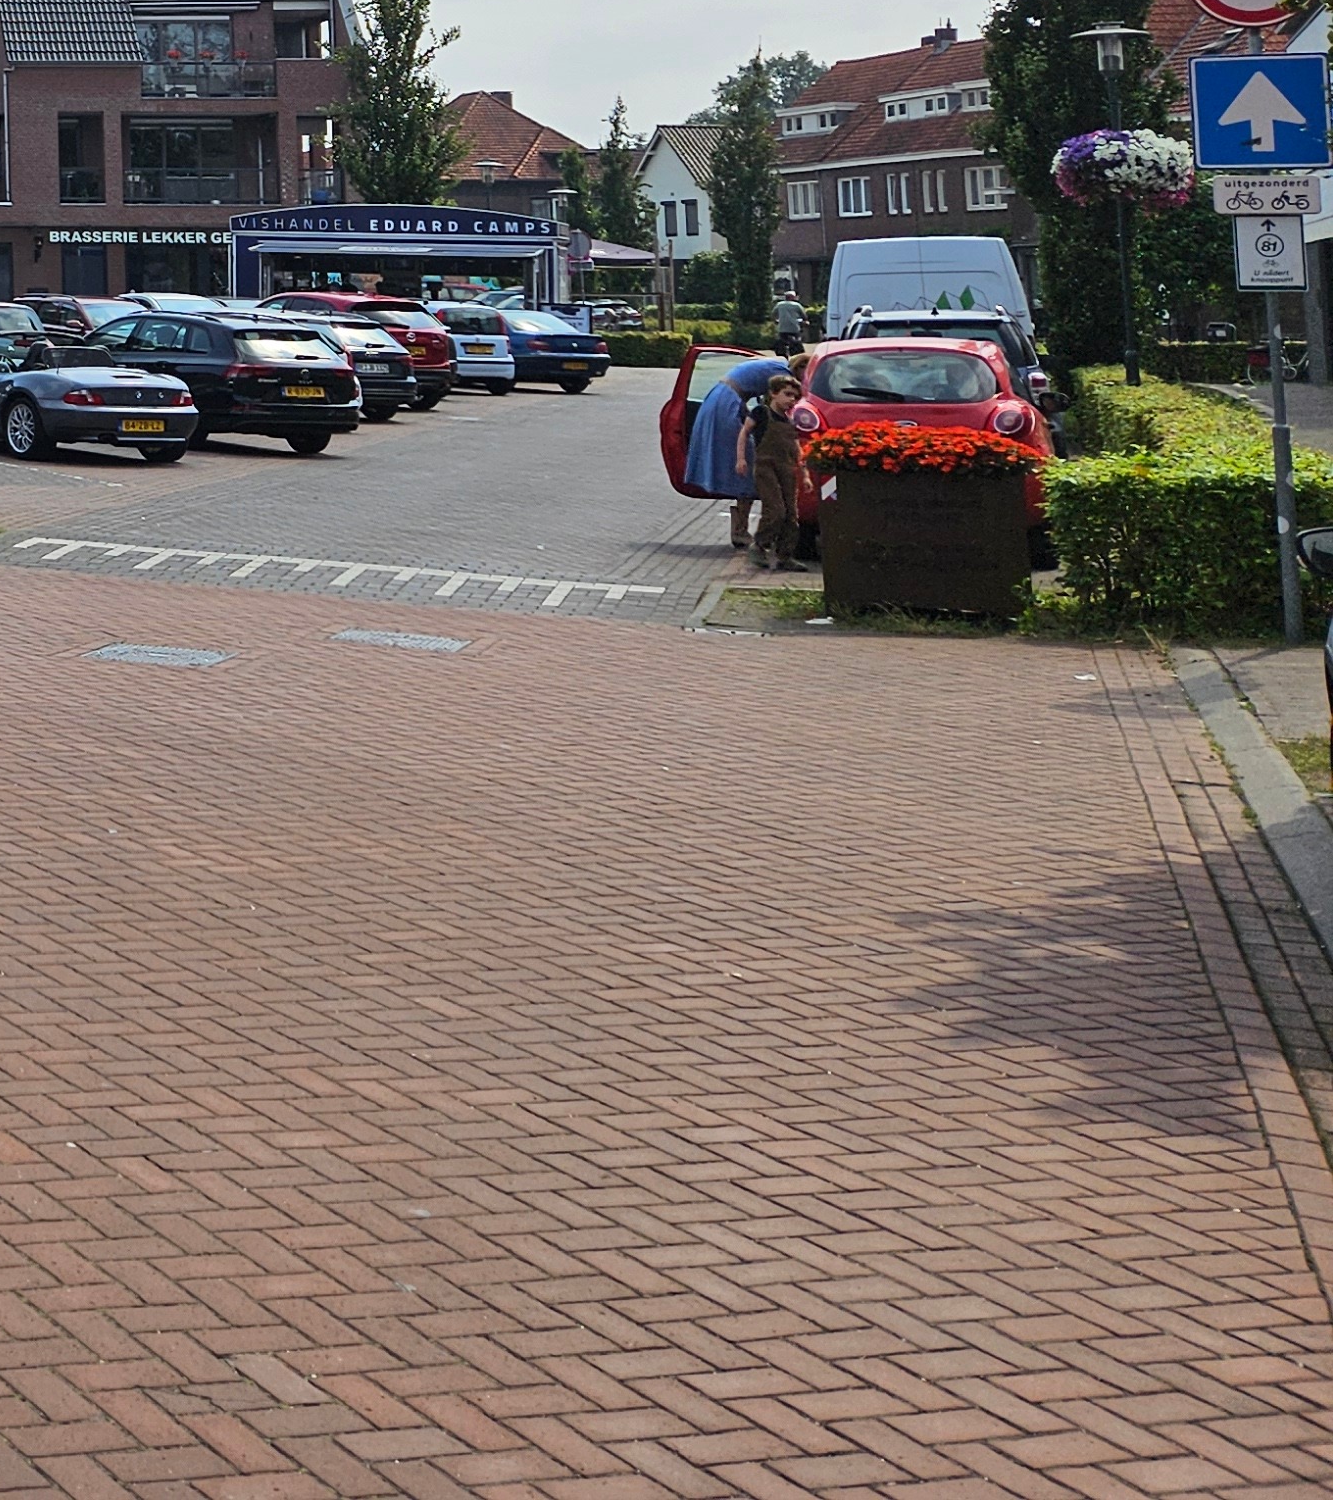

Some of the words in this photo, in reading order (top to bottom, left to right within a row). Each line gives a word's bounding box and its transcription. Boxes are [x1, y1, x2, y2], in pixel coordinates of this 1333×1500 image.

[1224, 179, 1310, 189] uitgezonderd
[238, 217, 355, 231] VISHANDEL
[369, 219, 459, 233] EDUARD
[473, 221, 551, 234] CAMPS
[49, 231, 138, 243] BRASSERIE
[142, 231, 207, 244] LEKKER
[1260, 240, 1277, 252] 81
